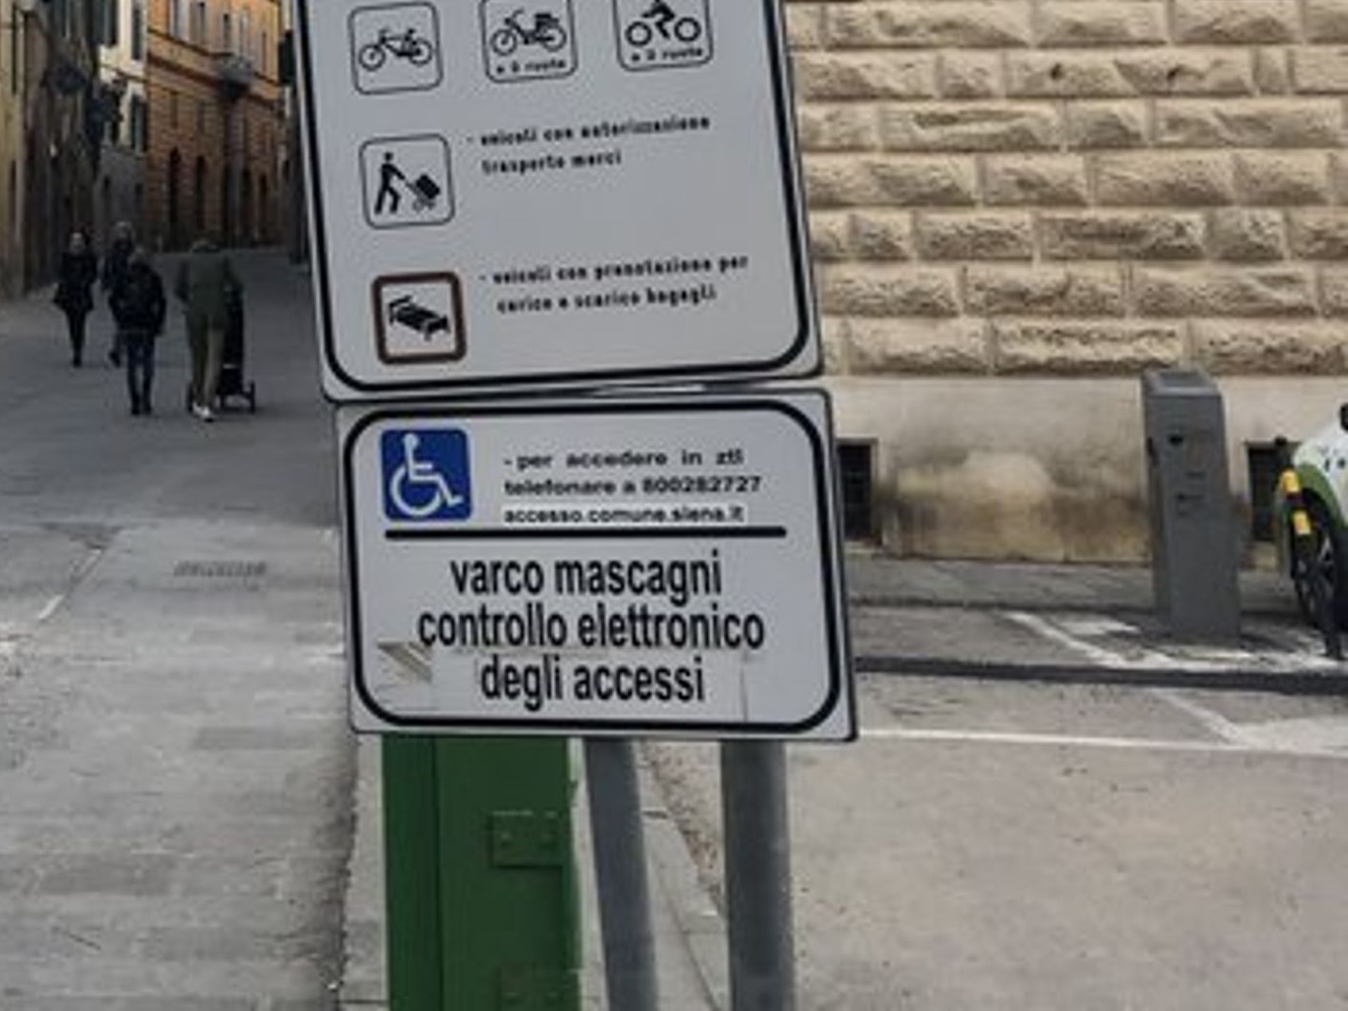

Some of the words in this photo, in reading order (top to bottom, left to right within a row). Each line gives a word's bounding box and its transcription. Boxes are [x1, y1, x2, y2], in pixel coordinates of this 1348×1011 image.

[481, 127, 537, 146] veicoli
[543, 128, 573, 142] con
[581, 115, 710, 138] autorizzazione
[482, 155, 564, 175] trasporto
[571, 149, 621, 167] merci
[493, 266, 550, 284] veicoli
[557, 267, 587, 281] con
[595, 258, 711, 281] prenotazione
[719, 256, 748, 273] per
[497, 297, 552, 313] carico
[575, 291, 640, 307] scarico
[646, 284, 717, 306] bagagli
[517, 455, 551, 471] per
[566, 450, 667, 468] accedere
[681, 449, 702, 465] in
[716, 448, 743, 465] ztl
[505, 479, 616, 495] telefonare
[624, 481, 636, 493] a
[643, 475, 761, 493] 800282727
[505, 505, 744, 523] accesso.comune.siena.it
[451, 560, 544, 595] varco
[555, 548, 721, 607] mascagni
[418, 602, 567, 647] controllo
[578, 602, 765, 649] elettronico
[481, 653, 562, 712] degli
[573, 656, 705, 702] accessi
